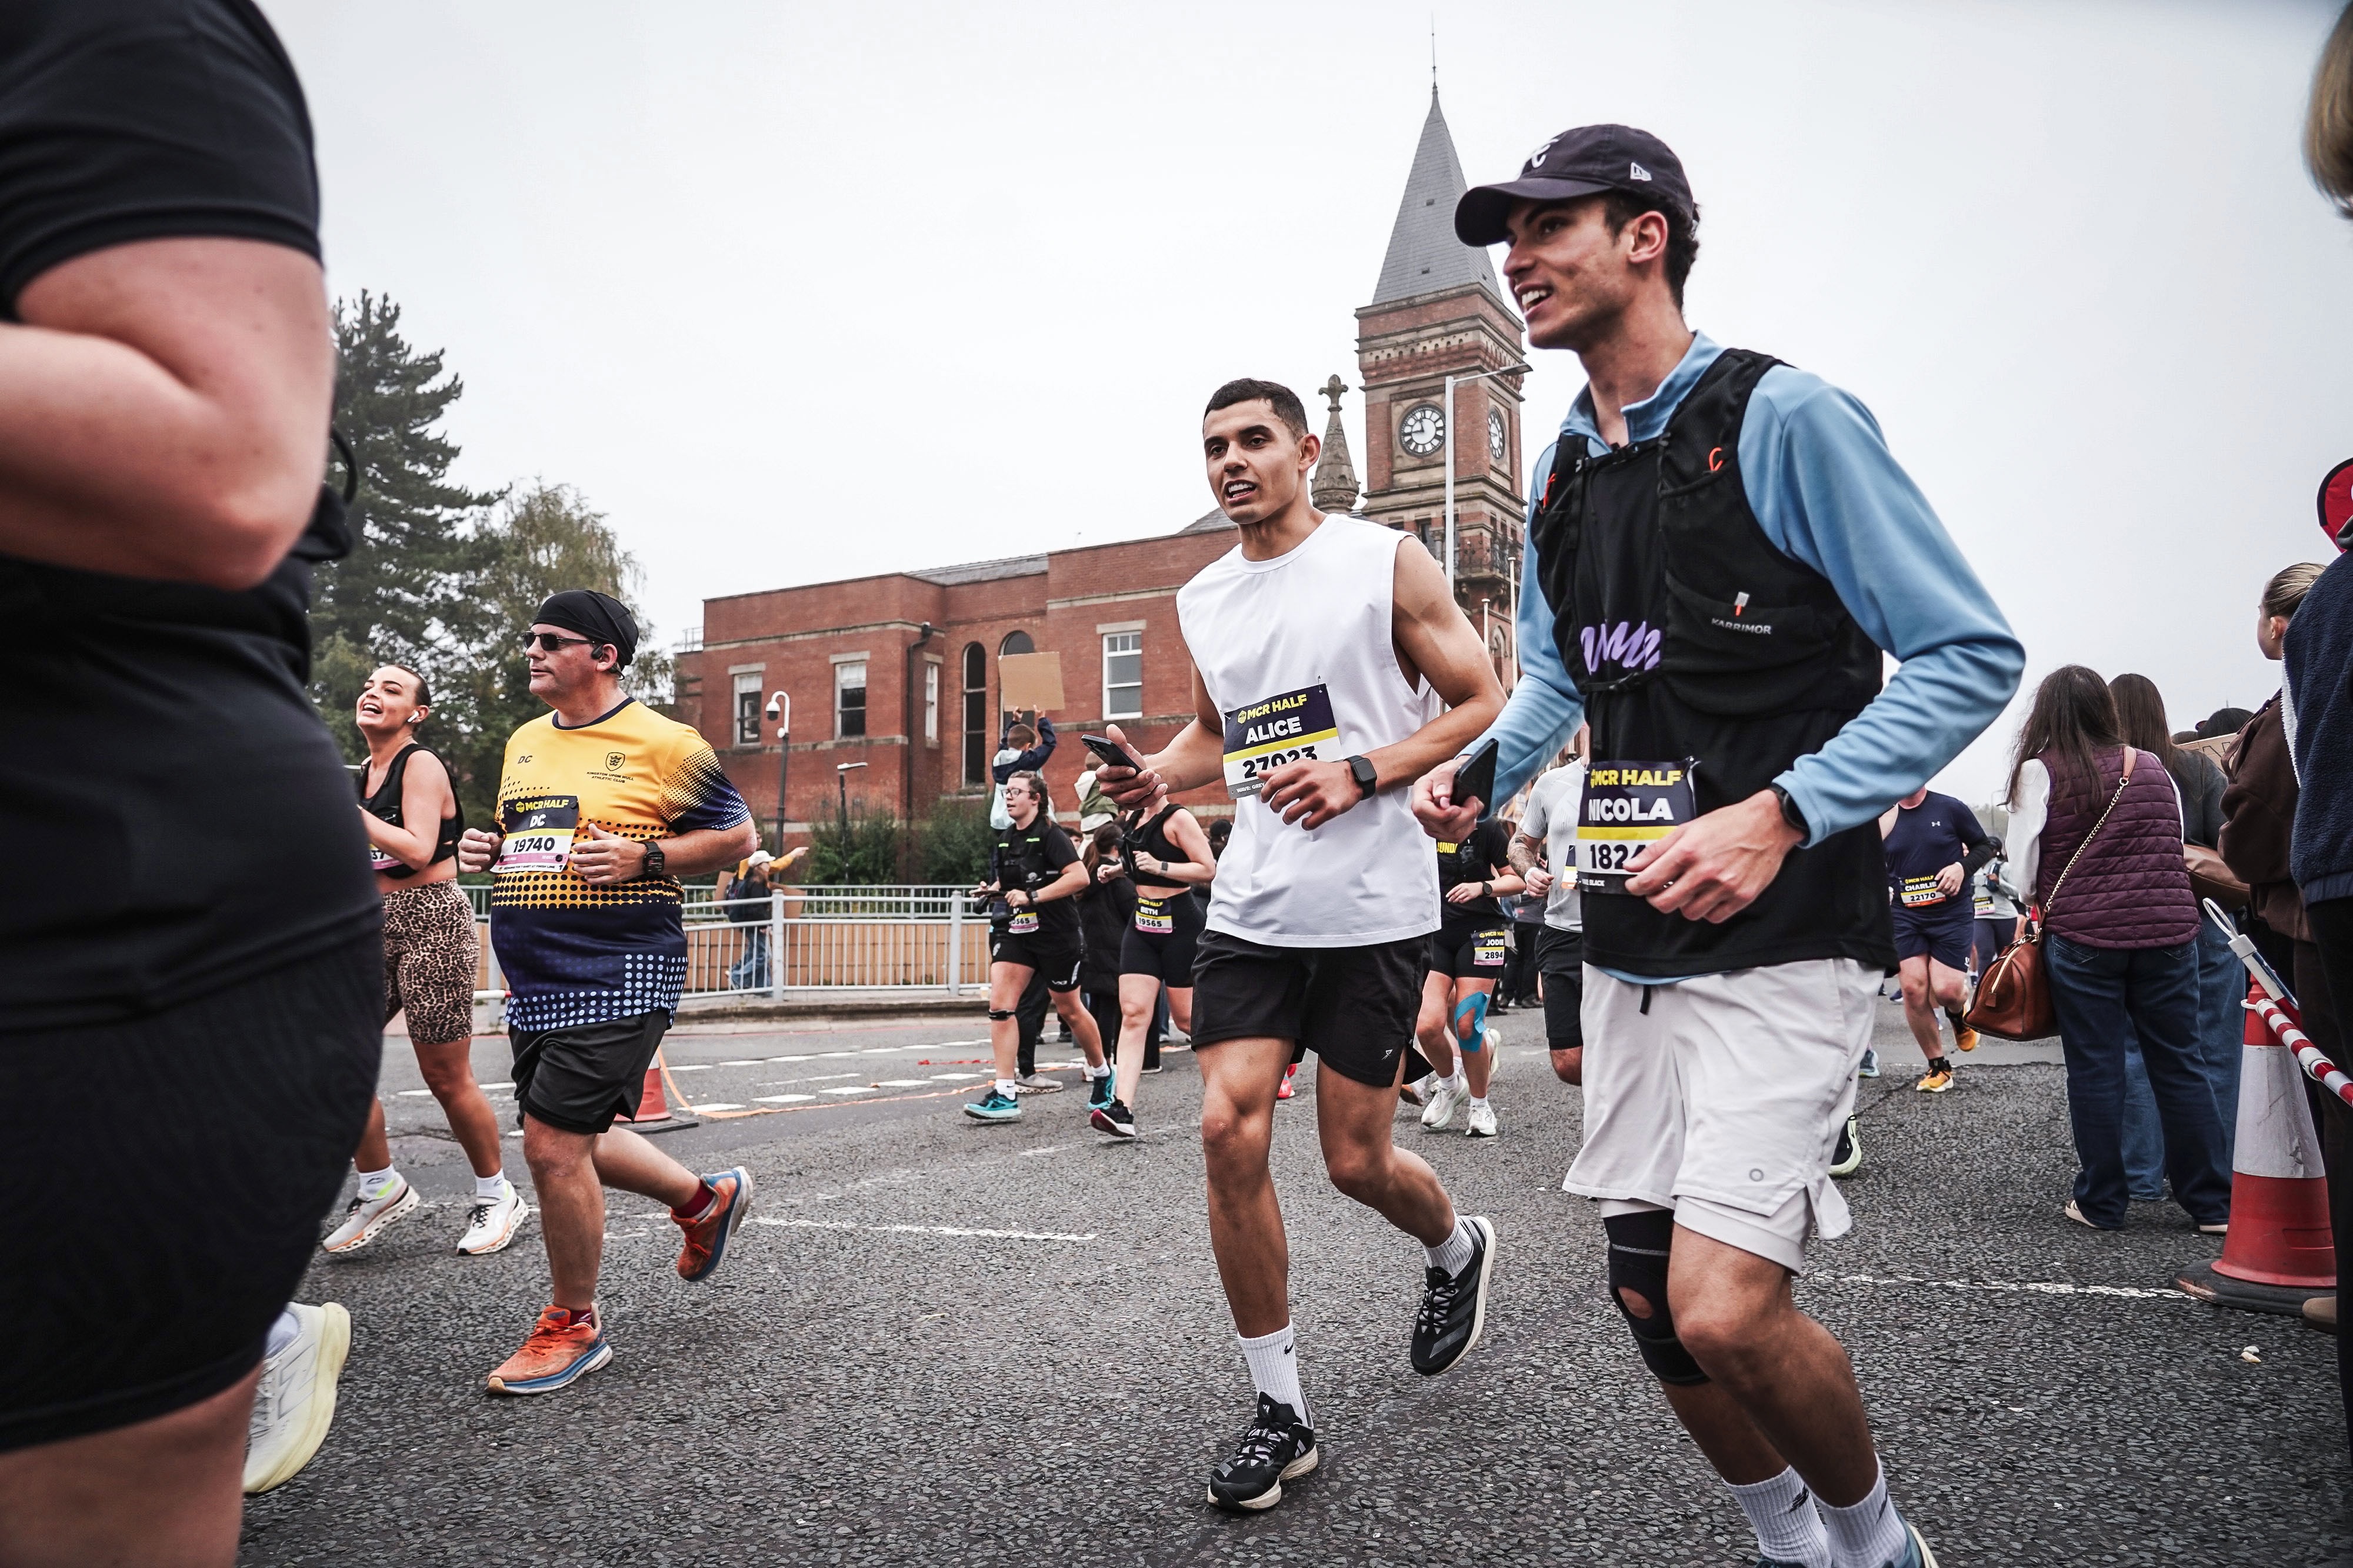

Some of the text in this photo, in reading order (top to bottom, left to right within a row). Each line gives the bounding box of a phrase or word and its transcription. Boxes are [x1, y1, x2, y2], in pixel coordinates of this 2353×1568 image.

[1711, 618, 1772, 635] KARRIMOR
[1247, 693, 1307, 720] MCR HALF
[1245, 716, 1302, 745] ALICE
[518, 755, 533, 764] DC
[1595, 769, 1682, 786] MCR HALF
[525, 799, 569, 810] MCR HALF
[1589, 797, 1675, 822] NICOLA
[529, 813, 546, 828] DC
[514, 837, 555, 853] 19740
[1905, 881, 1937, 892] CHARLIE
[1910, 892, 1936, 902] 22170
[1140, 906, 1158, 916] BETH
[1139, 918, 1162, 928] 19565
